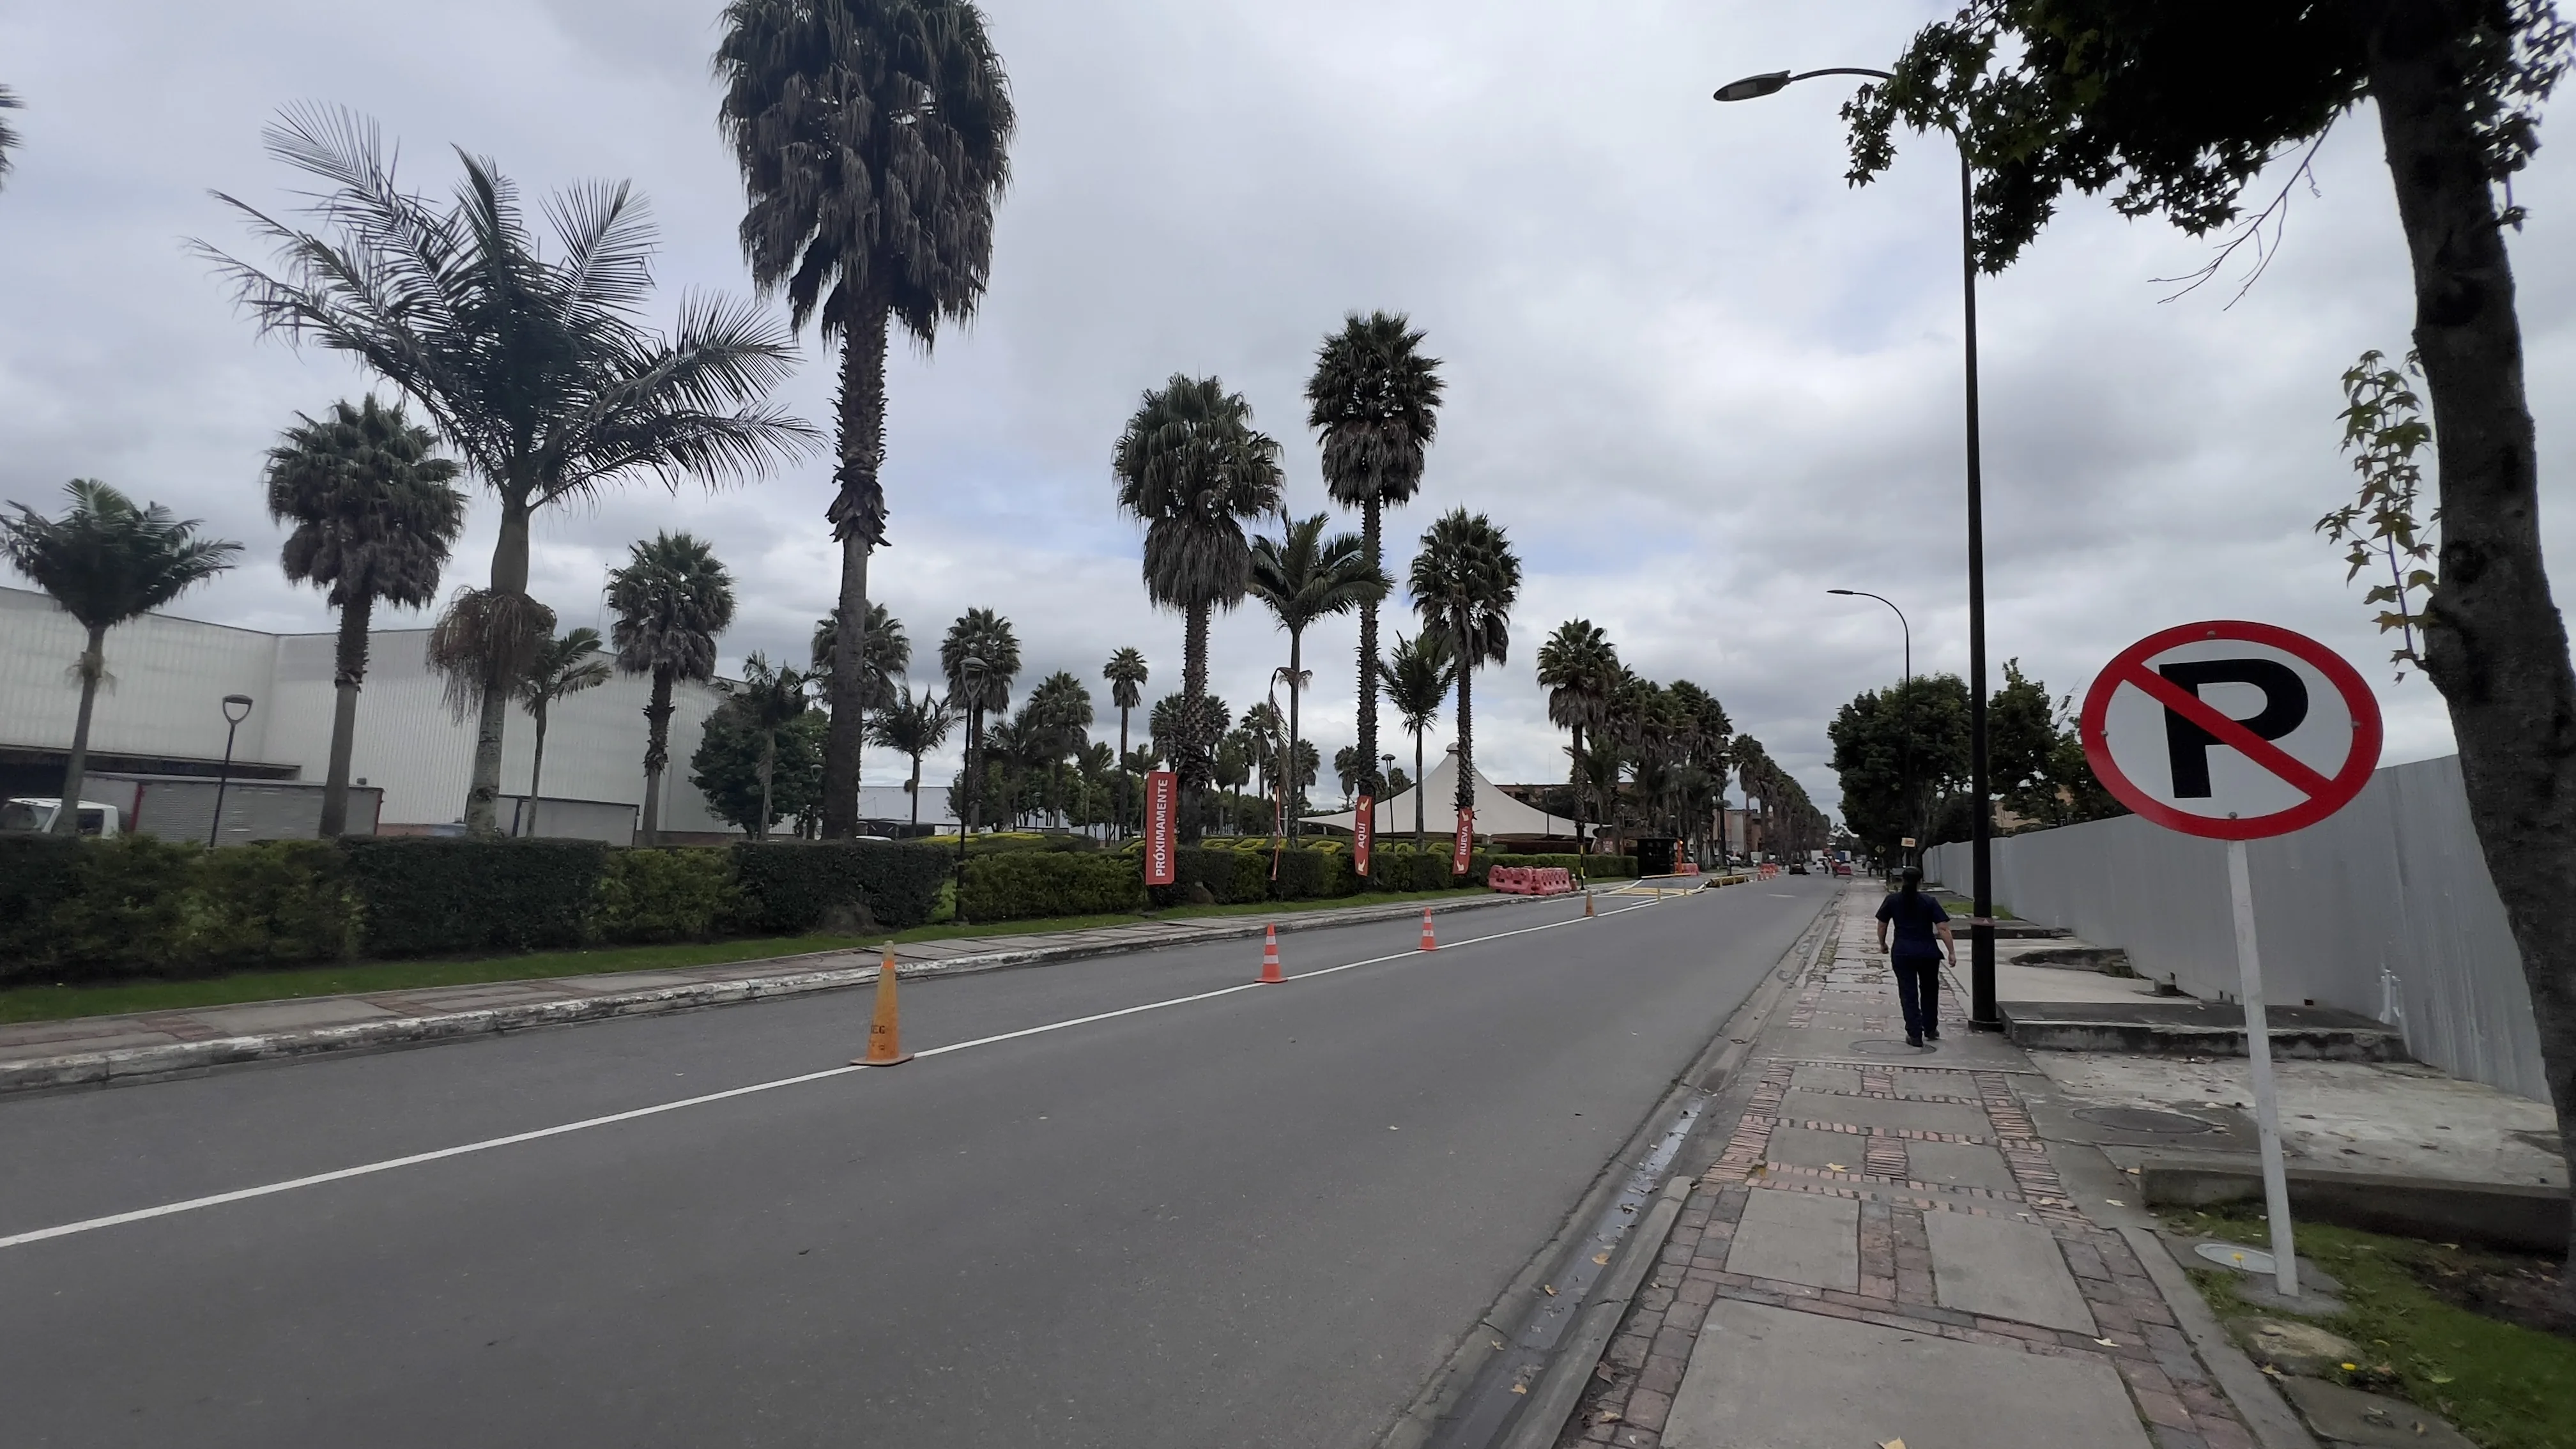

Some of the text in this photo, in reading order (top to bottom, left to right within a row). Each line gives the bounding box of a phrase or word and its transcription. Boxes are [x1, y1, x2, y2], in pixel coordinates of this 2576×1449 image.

[2159, 658, 2309, 799] P
[1153, 779, 1169, 877] PRÓXIMAMENTE
[1357, 822, 1366, 849] AQUÍ
[1459, 825, 1469, 856] NUEVA
